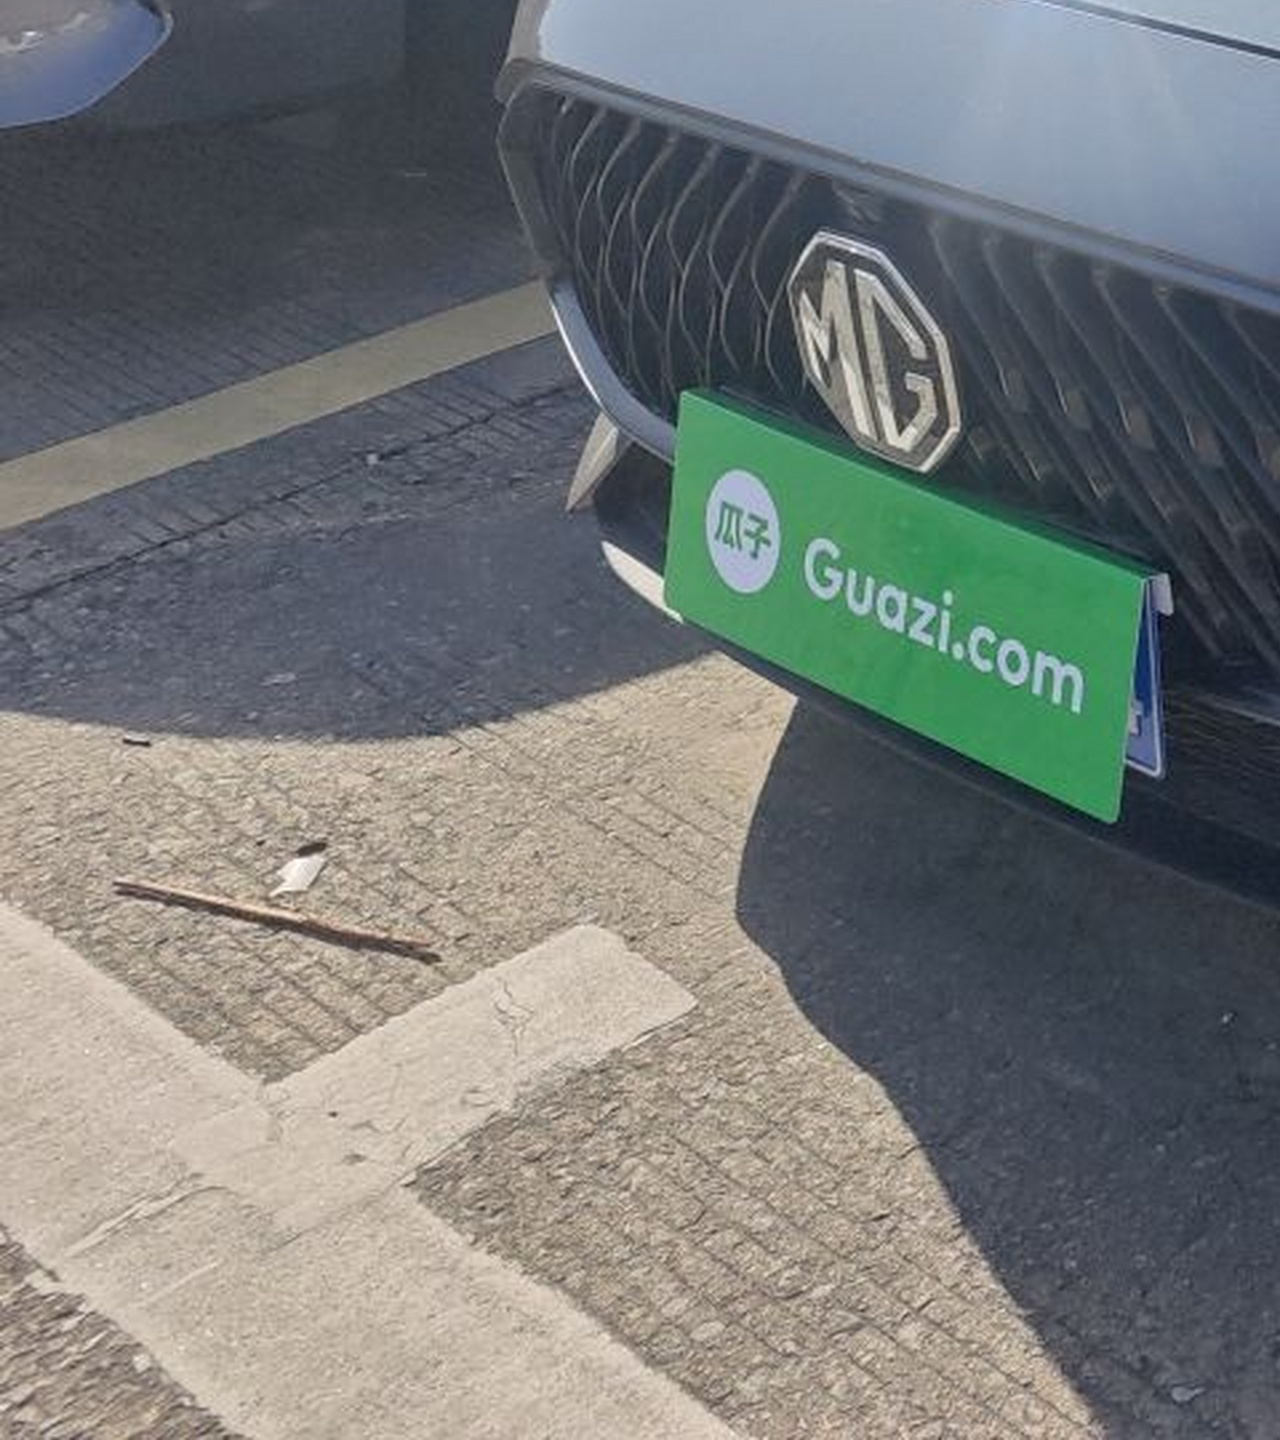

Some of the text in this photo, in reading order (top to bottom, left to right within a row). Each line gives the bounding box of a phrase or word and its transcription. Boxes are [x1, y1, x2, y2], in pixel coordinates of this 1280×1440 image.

[801, 259, 938, 452] MG
[714, 501, 771, 560] 瓜子
[804, 537, 1084, 714] Guazi.com
